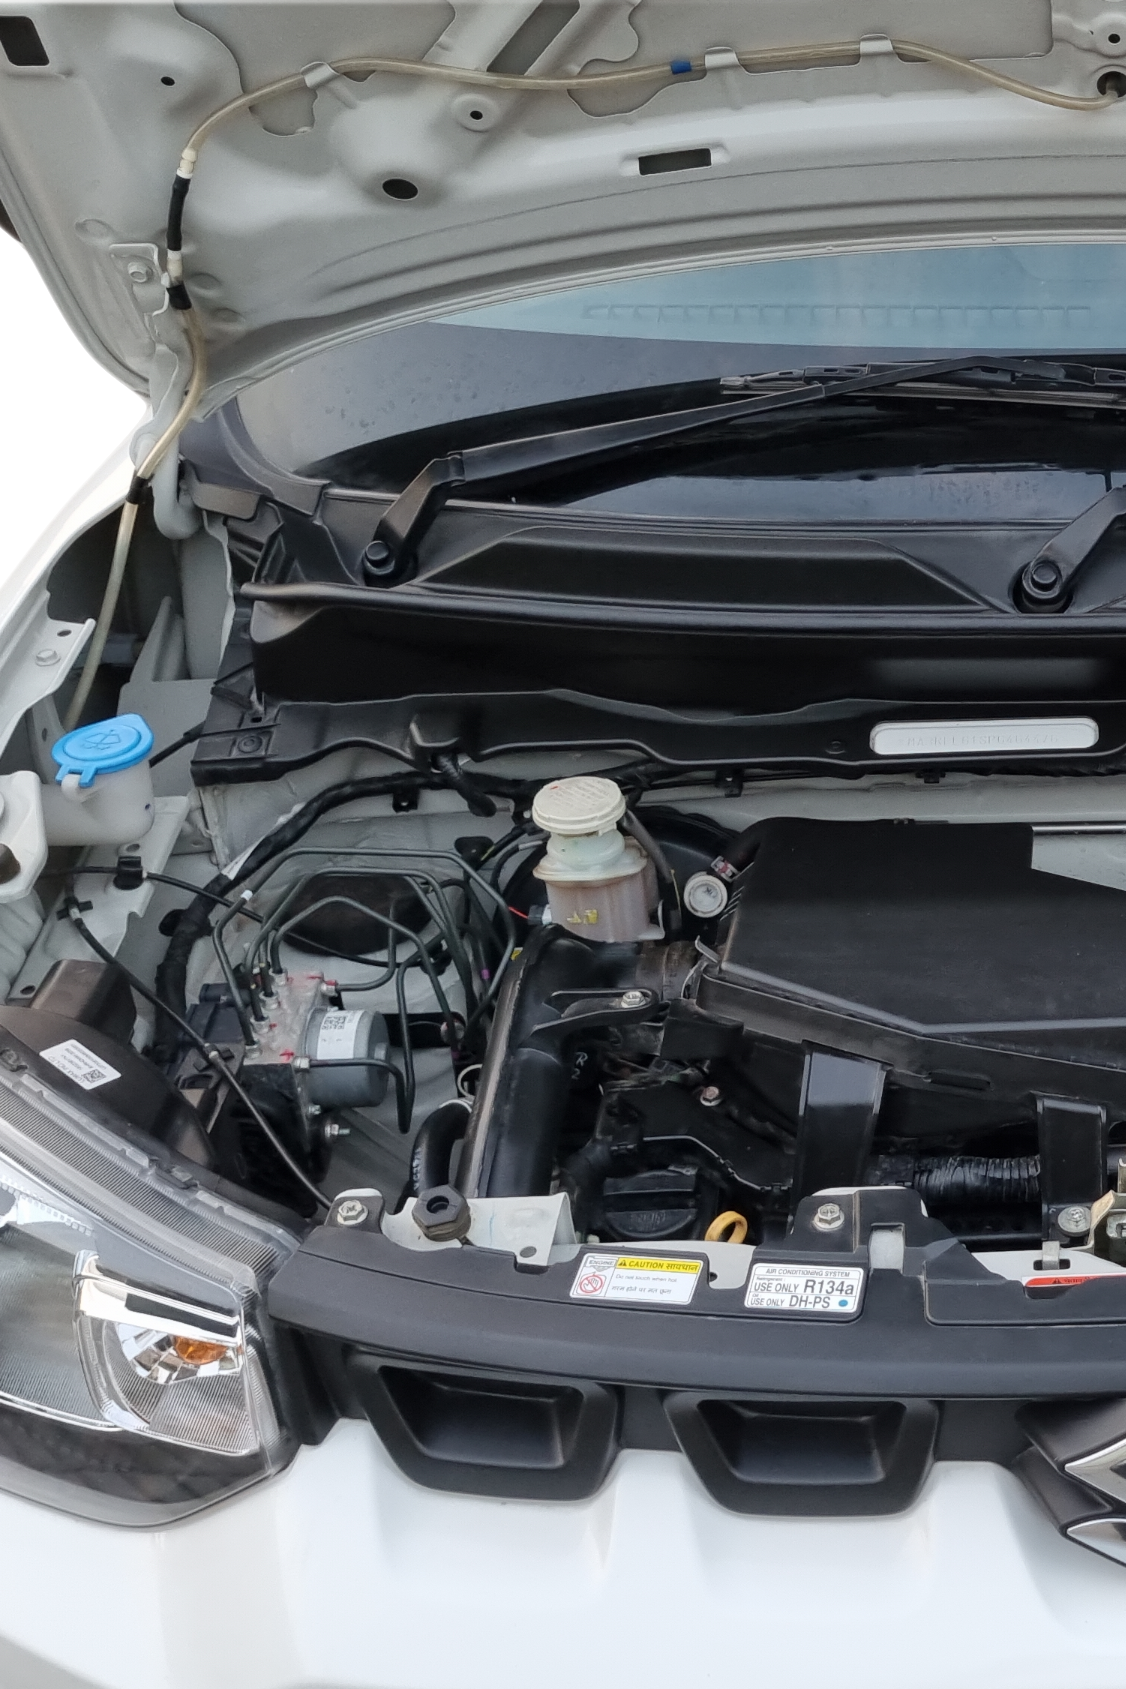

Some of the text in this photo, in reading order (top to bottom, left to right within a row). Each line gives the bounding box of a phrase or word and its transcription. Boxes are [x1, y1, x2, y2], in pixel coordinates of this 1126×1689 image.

[628, 1260, 664, 1269] CAUTION
[778, 1268, 823, 1276] CONDITIONING
[754, 1279, 854, 1295] USE ONLY R134a
[750, 1295, 831, 1309] USE ONLY DH-PS
